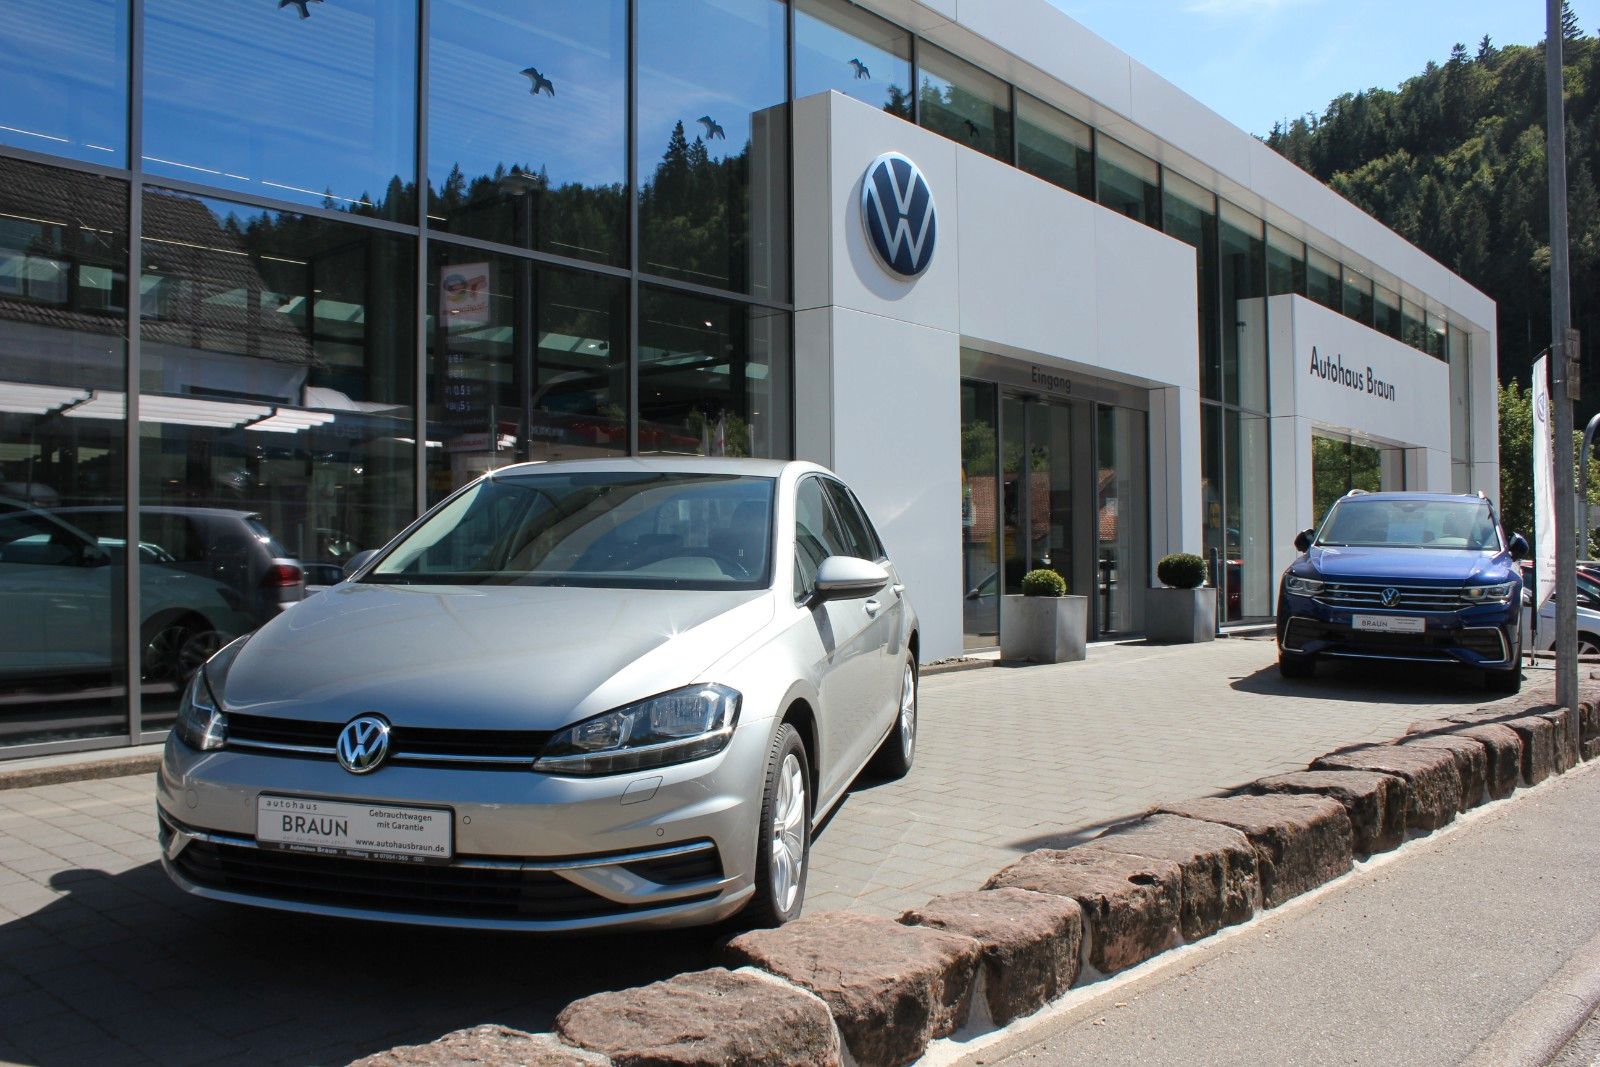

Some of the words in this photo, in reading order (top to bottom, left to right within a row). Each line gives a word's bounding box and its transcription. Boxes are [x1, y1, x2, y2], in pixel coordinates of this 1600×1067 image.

[1032, 366, 1071, 394] Eingang
[1310, 346, 1364, 391] Autohaus
[1366, 366, 1395, 402] Braun
[266, 800, 318, 811] autohaus
[369, 809, 432, 822] Gebrauchtwagen
[282, 815, 348, 837] BRAUN
[376, 821, 390, 829] mit
[391, 821, 424, 832] Garantie
[355, 839, 445, 853] www.autohausbraun.de
